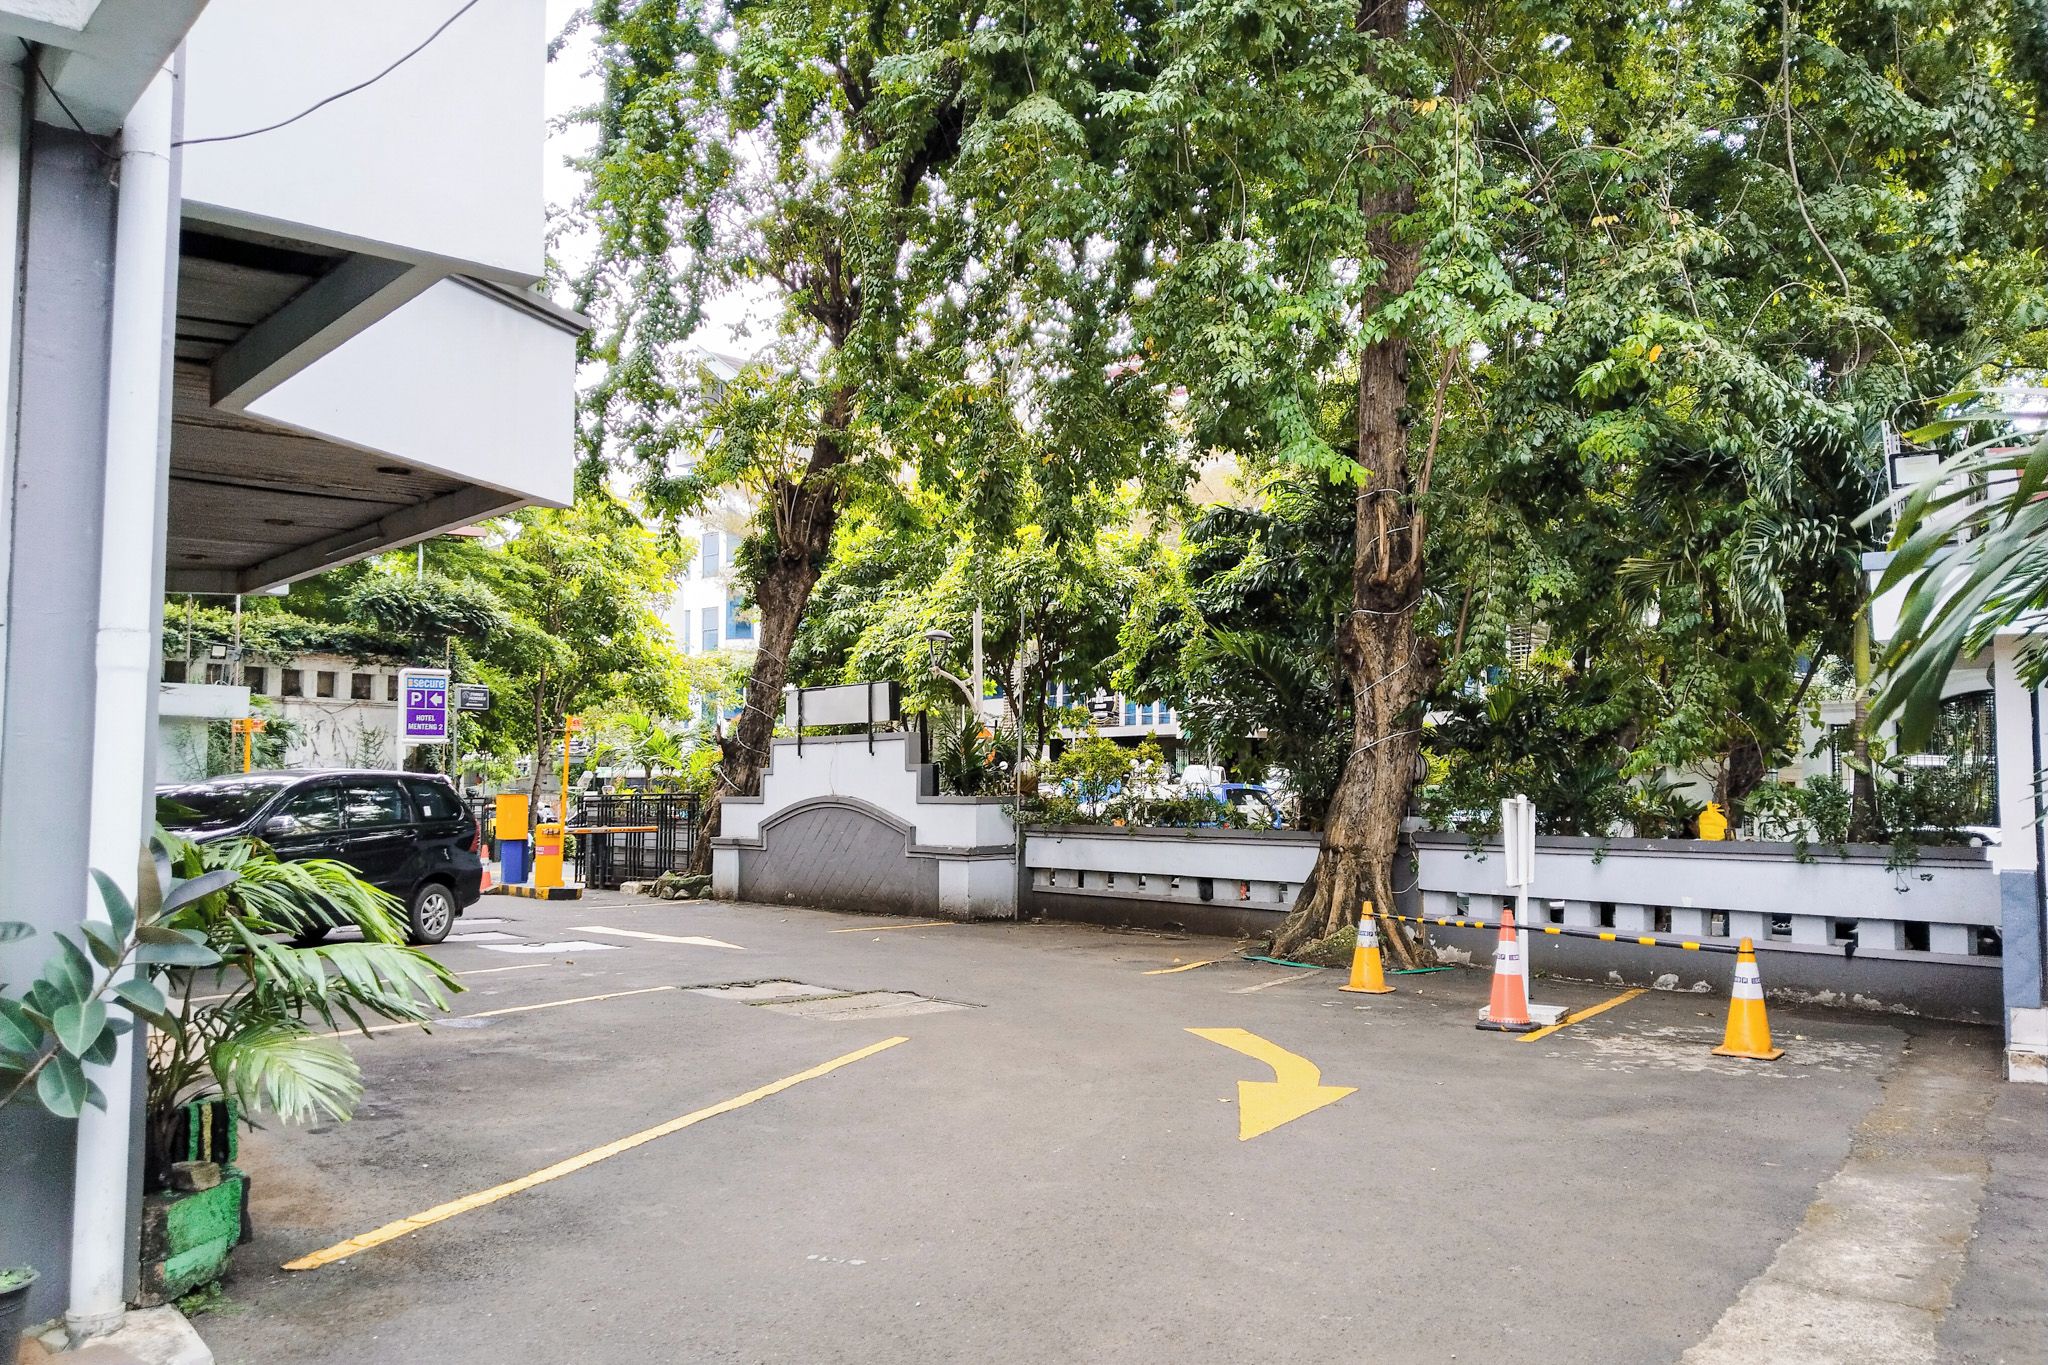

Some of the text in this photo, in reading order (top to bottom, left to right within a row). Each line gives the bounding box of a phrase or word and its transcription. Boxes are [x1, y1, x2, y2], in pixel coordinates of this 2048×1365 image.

[411, 692, 422, 706] P
[415, 714, 435, 722] HOTEL
[408, 722, 438, 730] MENTENG
